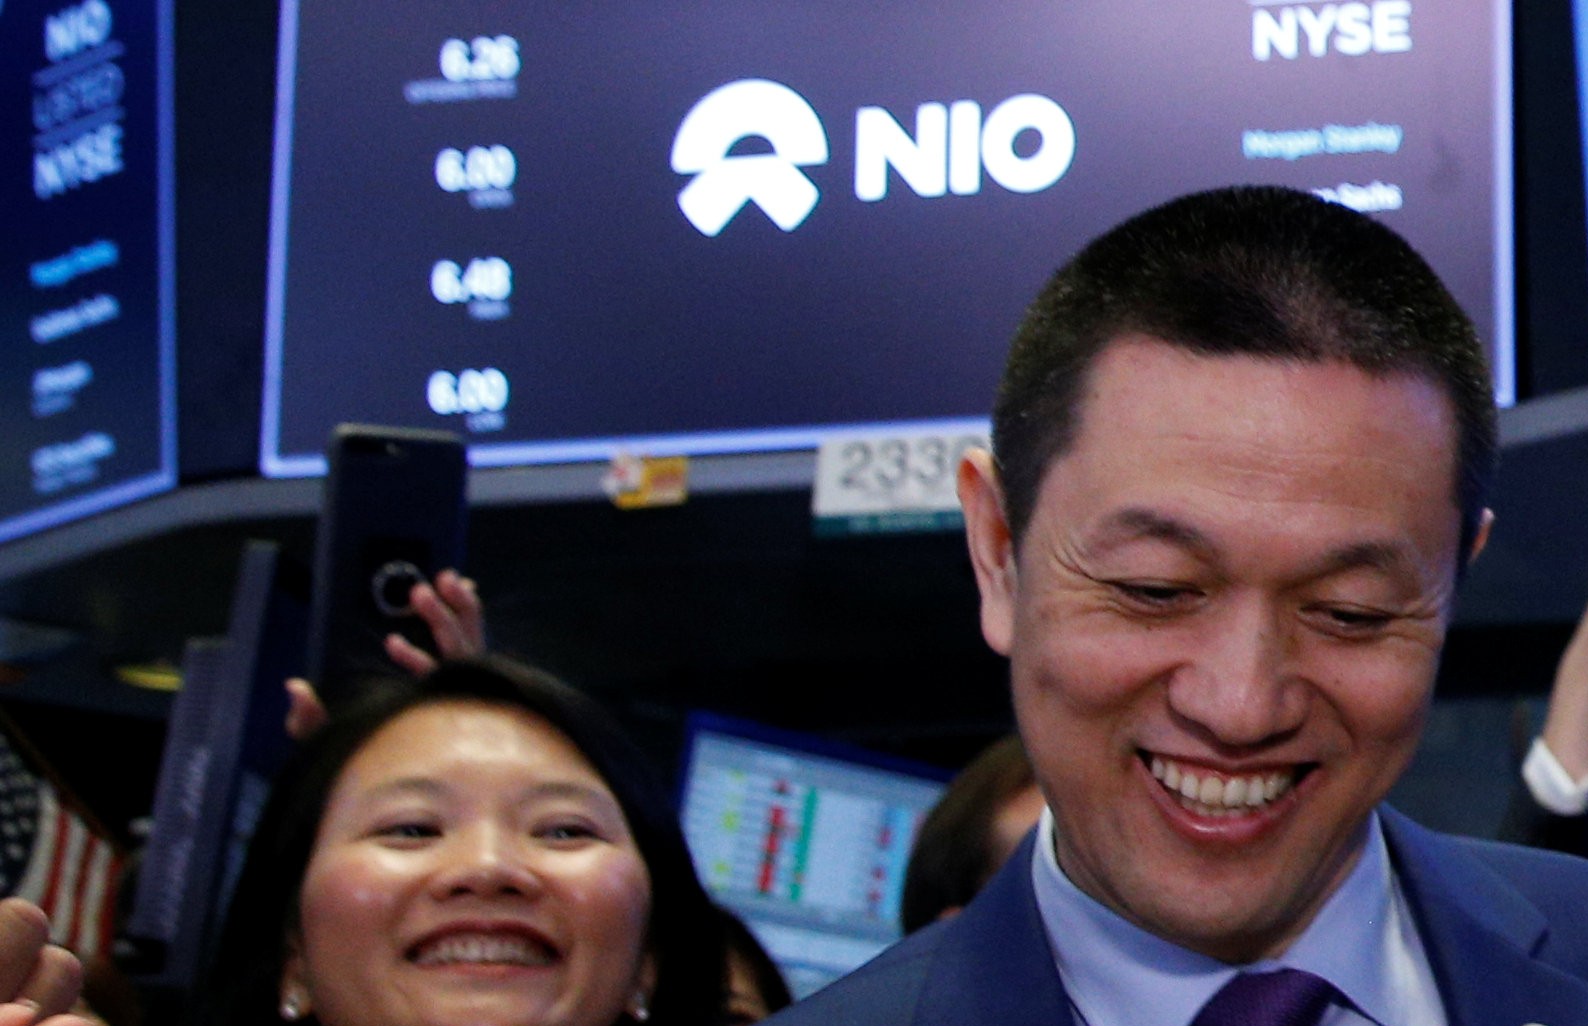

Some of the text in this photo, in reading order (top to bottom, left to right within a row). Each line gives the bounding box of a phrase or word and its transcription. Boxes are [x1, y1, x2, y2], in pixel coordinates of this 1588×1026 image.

[1252, 0, 1413, 62] NYSE
[434, 144, 516, 192] 6.00
[854, 92, 1076, 202] NIO
[426, 367, 508, 415] 6.00
